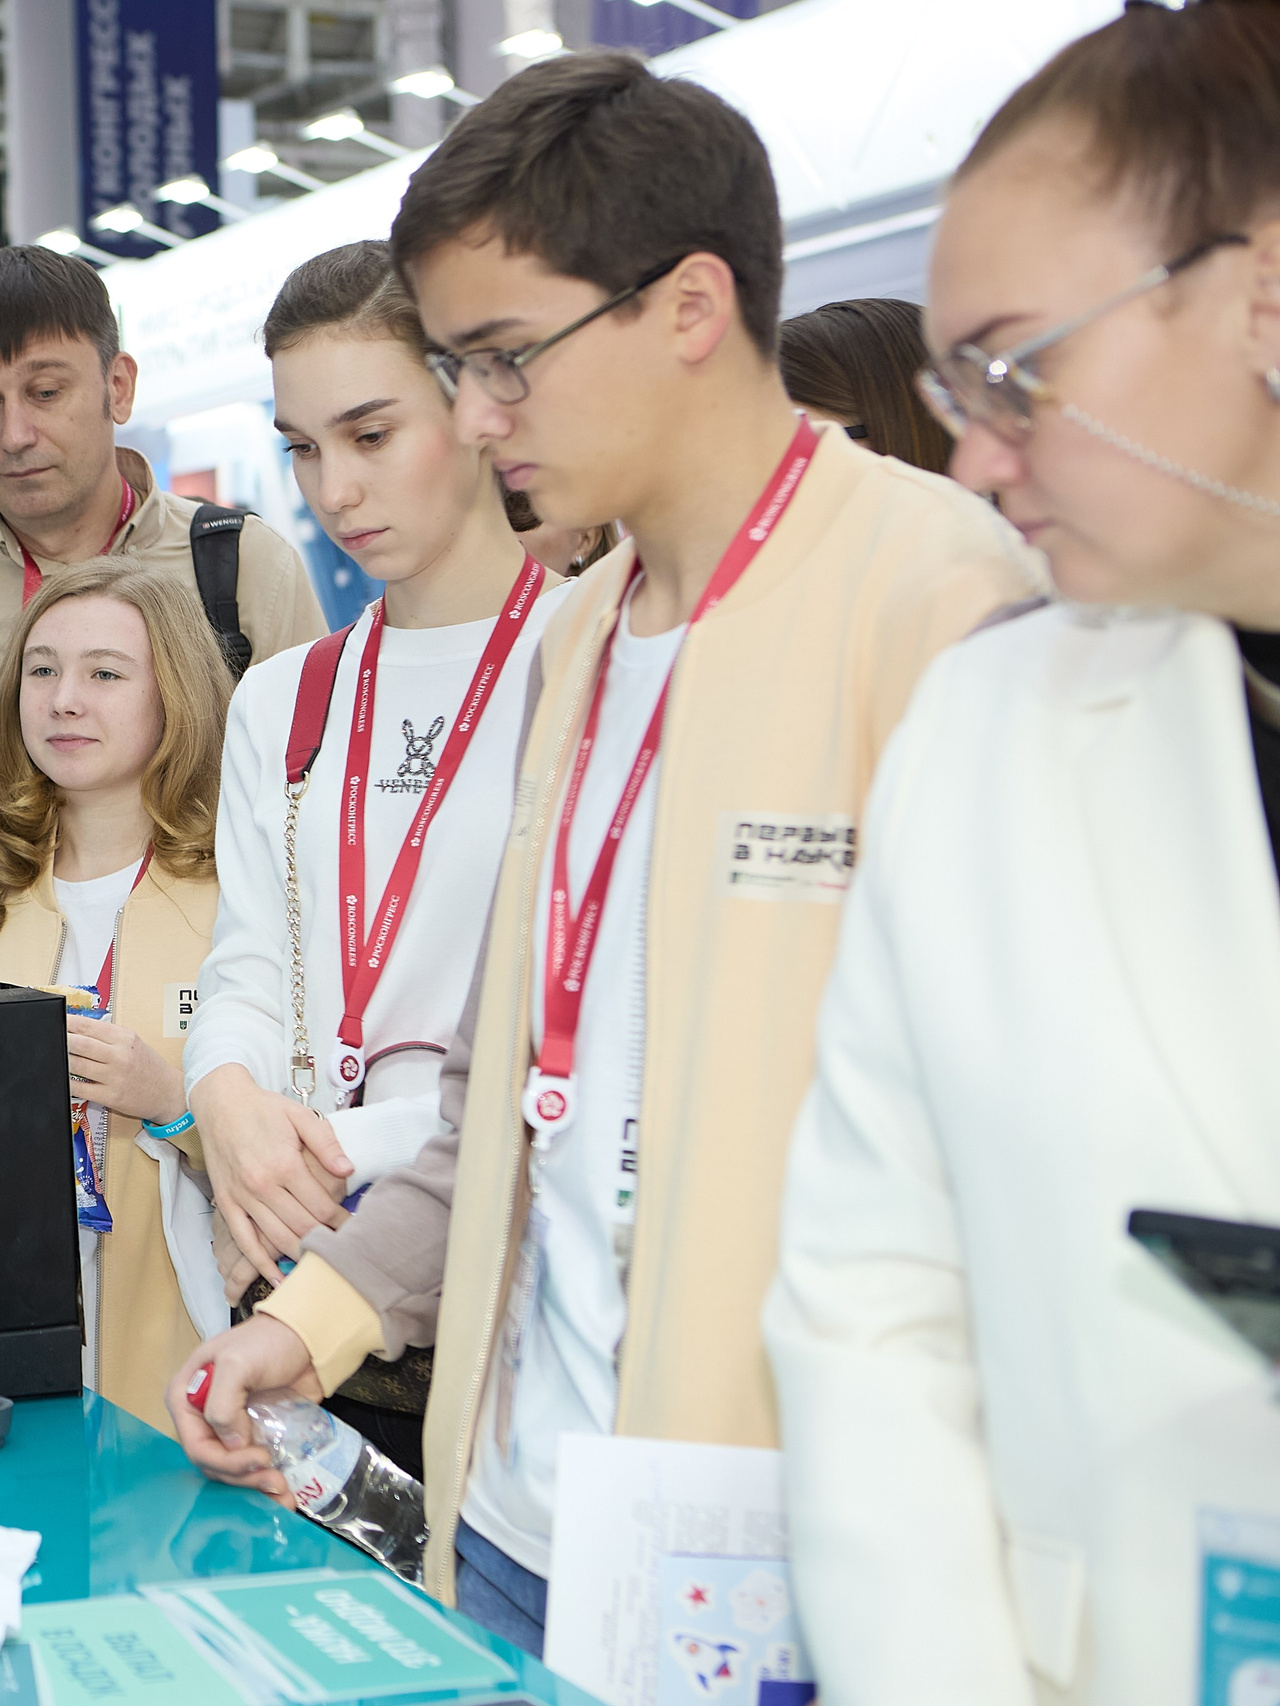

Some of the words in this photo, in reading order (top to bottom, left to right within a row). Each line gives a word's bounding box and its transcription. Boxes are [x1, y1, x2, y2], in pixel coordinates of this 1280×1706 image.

[357, 678, 370, 733] ROSCONGRESS
[462, 663, 495, 722] РОСКОНГРЕСС
[347, 785, 358, 846] РОСКОНГРЕСС
[379, 778, 431, 794] VENE
[414, 777, 445, 837] ROSCONGRESS
[733, 843, 750, 860] В
[347, 905, 358, 967] ROSCONGRESS
[372, 895, 400, 958] РОСКОНГРЕСС
[179, 1003, 193, 1014] В
